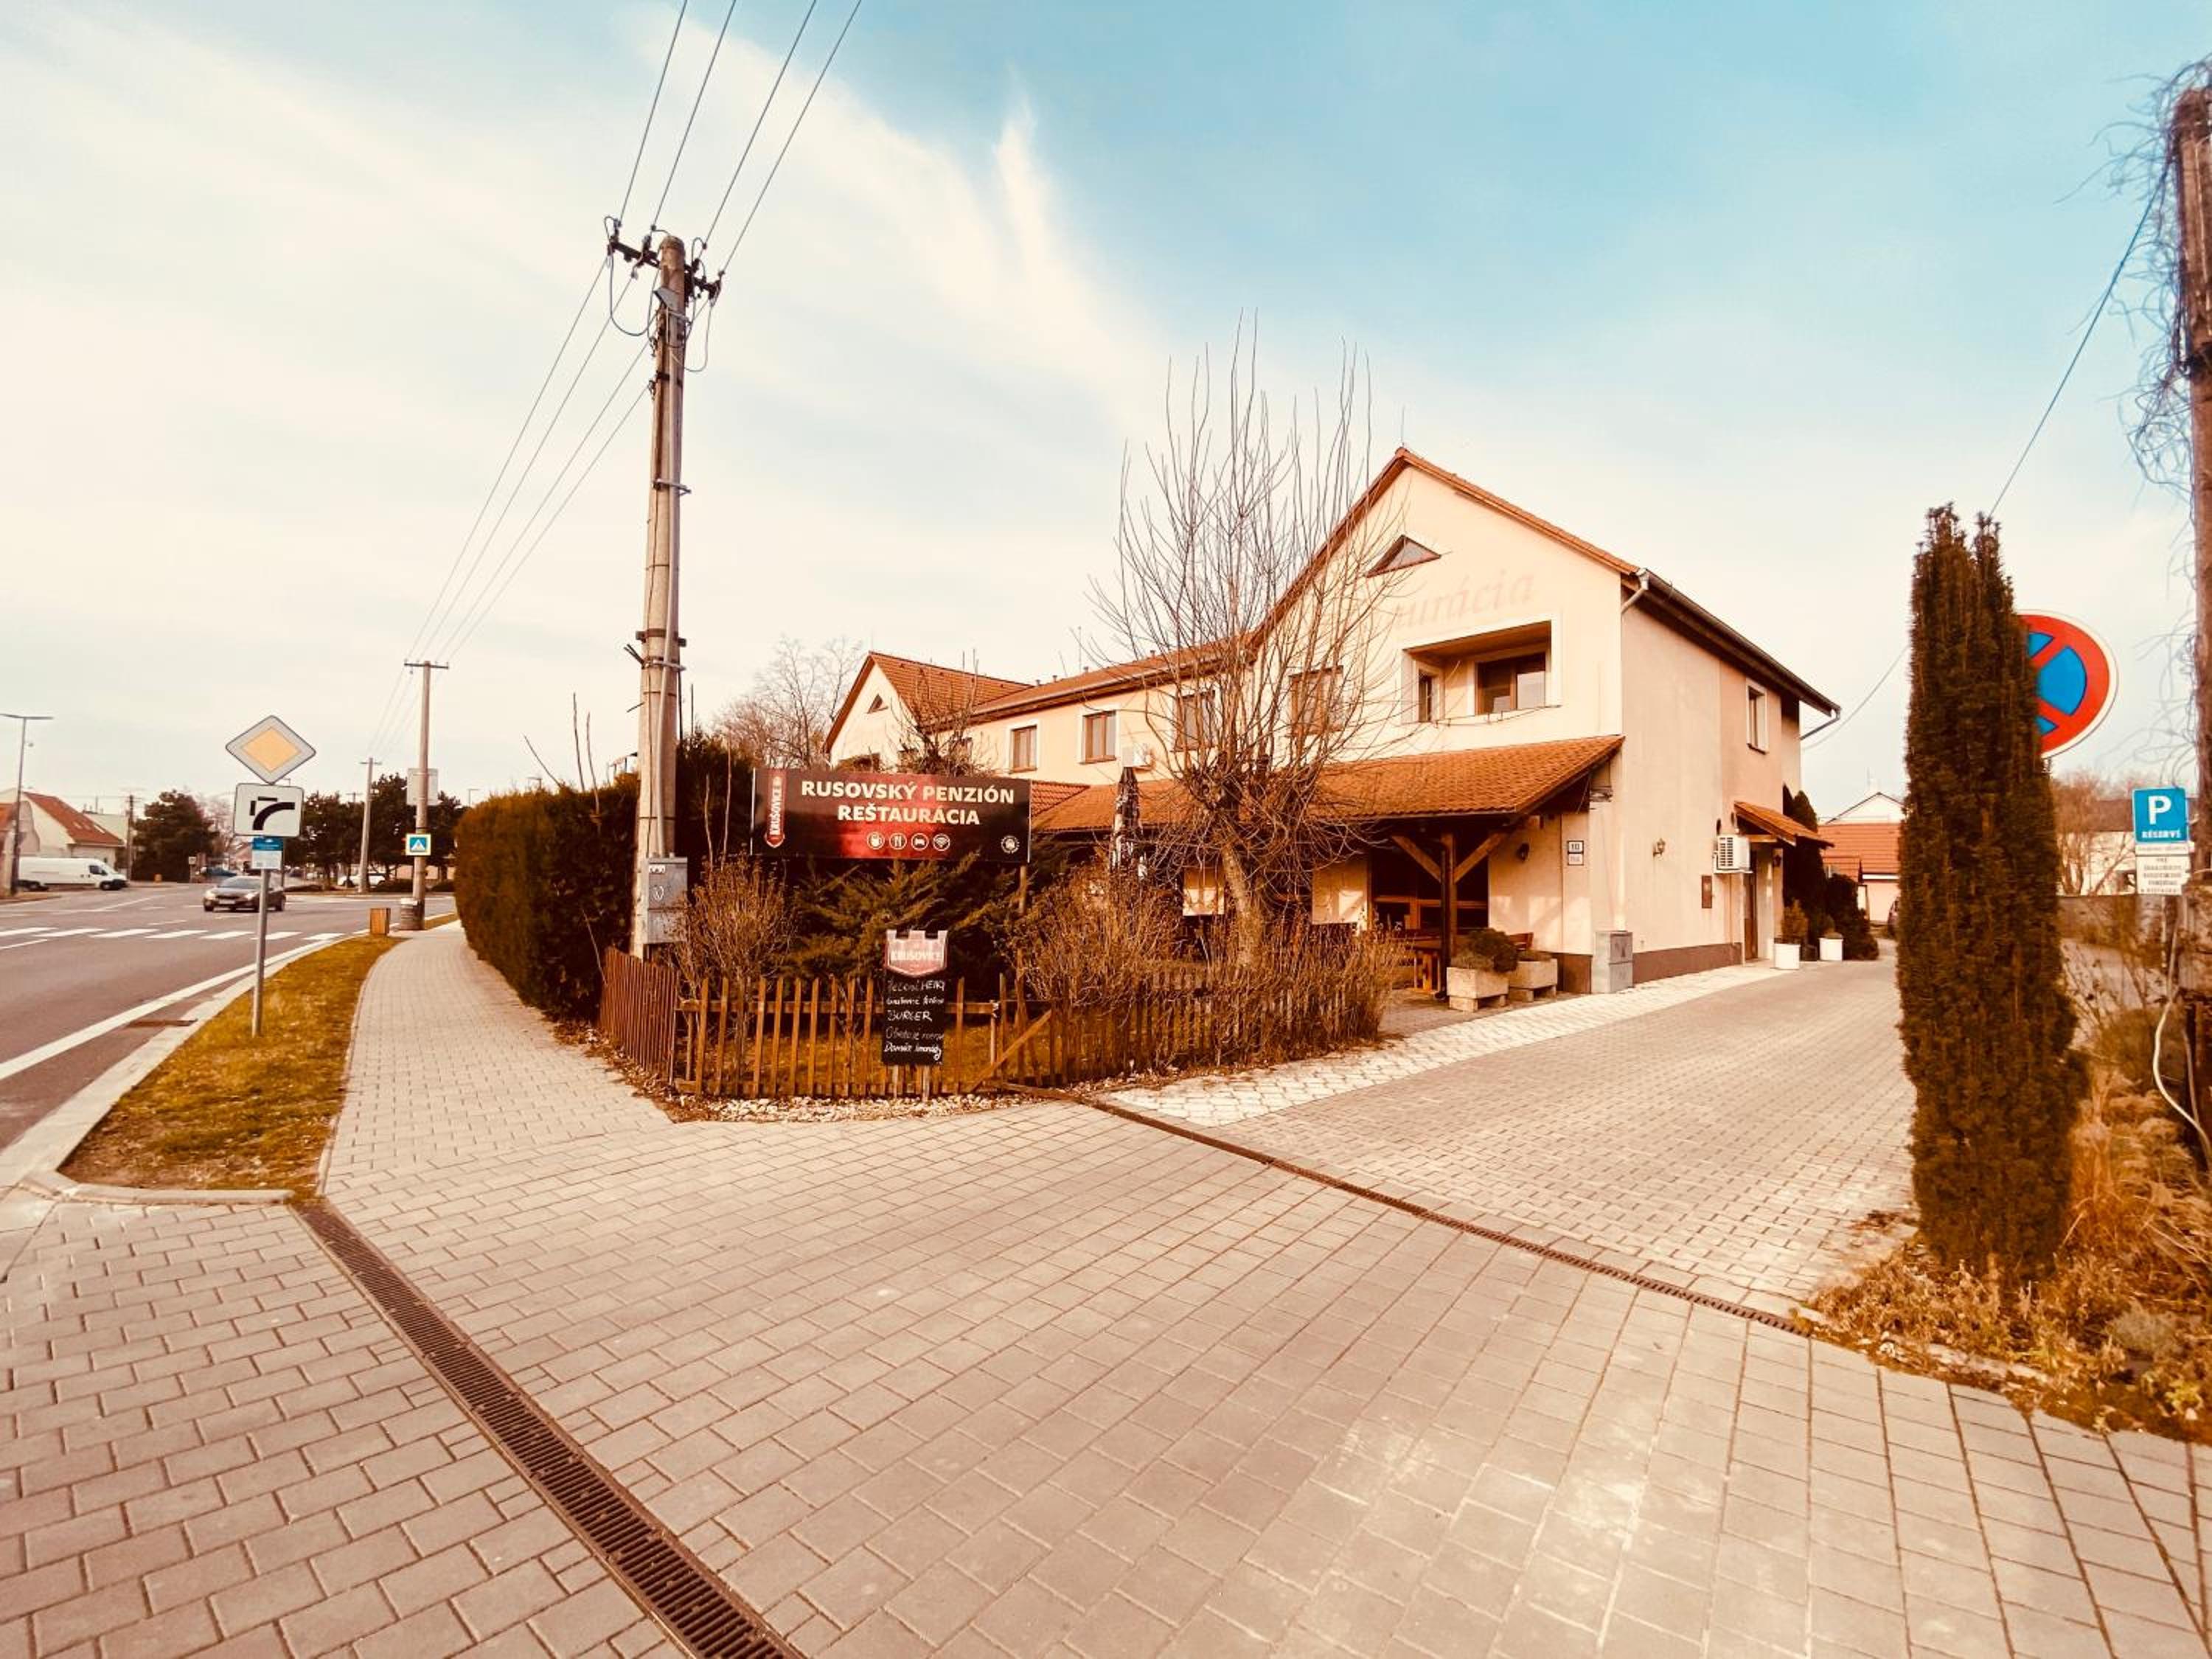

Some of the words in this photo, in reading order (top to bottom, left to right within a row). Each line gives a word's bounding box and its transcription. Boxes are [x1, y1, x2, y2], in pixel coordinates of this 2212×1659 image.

[801, 781, 917, 800] RUSOVSKÝ
[923, 785, 1014, 804] PENZIÓN
[838, 804, 980, 825] REŠTAURÁCIA
[2148, 795, 2171, 825] P
